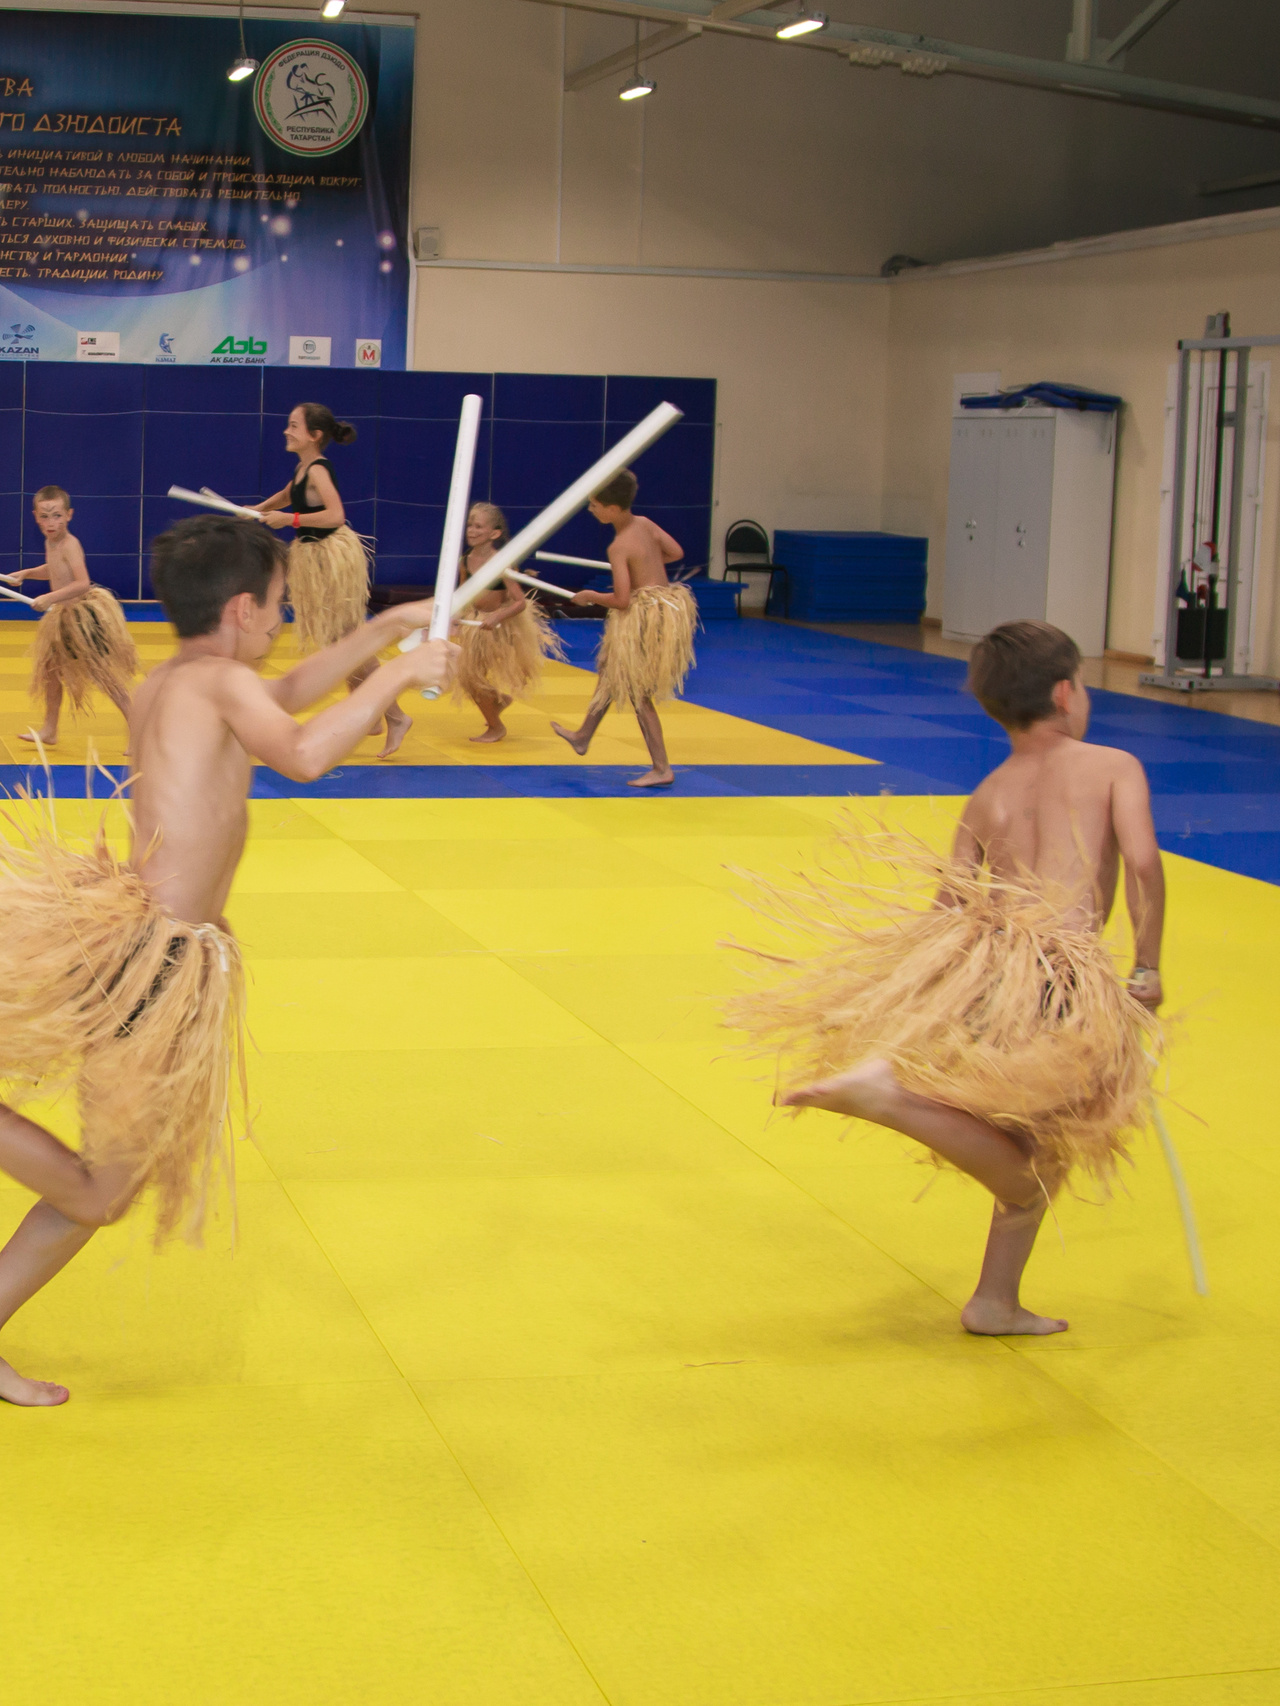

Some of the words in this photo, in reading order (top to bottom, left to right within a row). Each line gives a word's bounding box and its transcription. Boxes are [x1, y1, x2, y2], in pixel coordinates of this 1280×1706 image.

[278, 49, 320, 67] ФЕДЕРАЦИЯ
[321, 52, 346, 71] ДЗЮДО
[33, 112, 182, 138] ДЗЮДОИСТА
[286, 125, 335, 134] РЕСПУБЛИКА
[290, 133, 332, 142] ТАТАРСТАН
[7, 149, 103, 163] ИНИЦИАТИВОЙ
[107, 152, 113, 161] В
[117, 152, 165, 163] ЛЮБОМ
[49, 166, 132, 179] НАБЛЮДАТЬ
[136, 169, 153, 180] ЗА
[157, 169, 194, 181] СОБОЙ
[198, 171, 208, 182] И
[211, 172, 316, 187] ПРОИСХОДЯЩИМ
[126, 184, 213, 198] ДЕЙСТВОВАТЬ
[79, 218, 154, 232] ЗАЩИЩАТЬ
[33, 234, 91, 245] ДУХОВНО
[94, 236, 103, 245] И
[183, 238, 247, 249] СТРЕМЯСЬ
[42, 251, 52, 261] И
